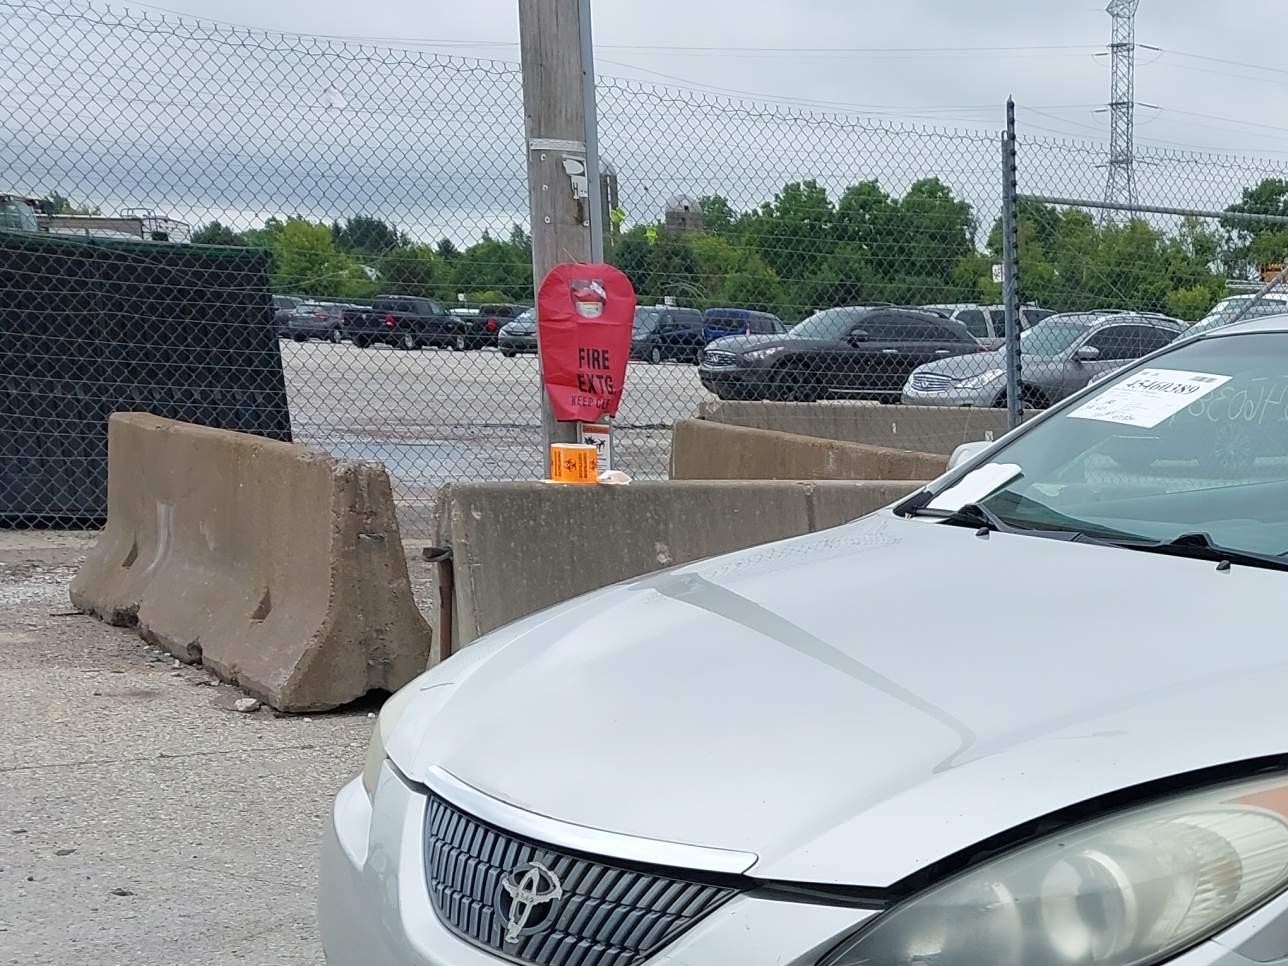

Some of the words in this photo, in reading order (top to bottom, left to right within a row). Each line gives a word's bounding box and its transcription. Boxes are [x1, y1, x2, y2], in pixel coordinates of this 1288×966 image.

[578, 347, 610, 370] FIRE
[576, 373, 617, 395] EXTG.
[571, 394, 594, 407] KEEP
